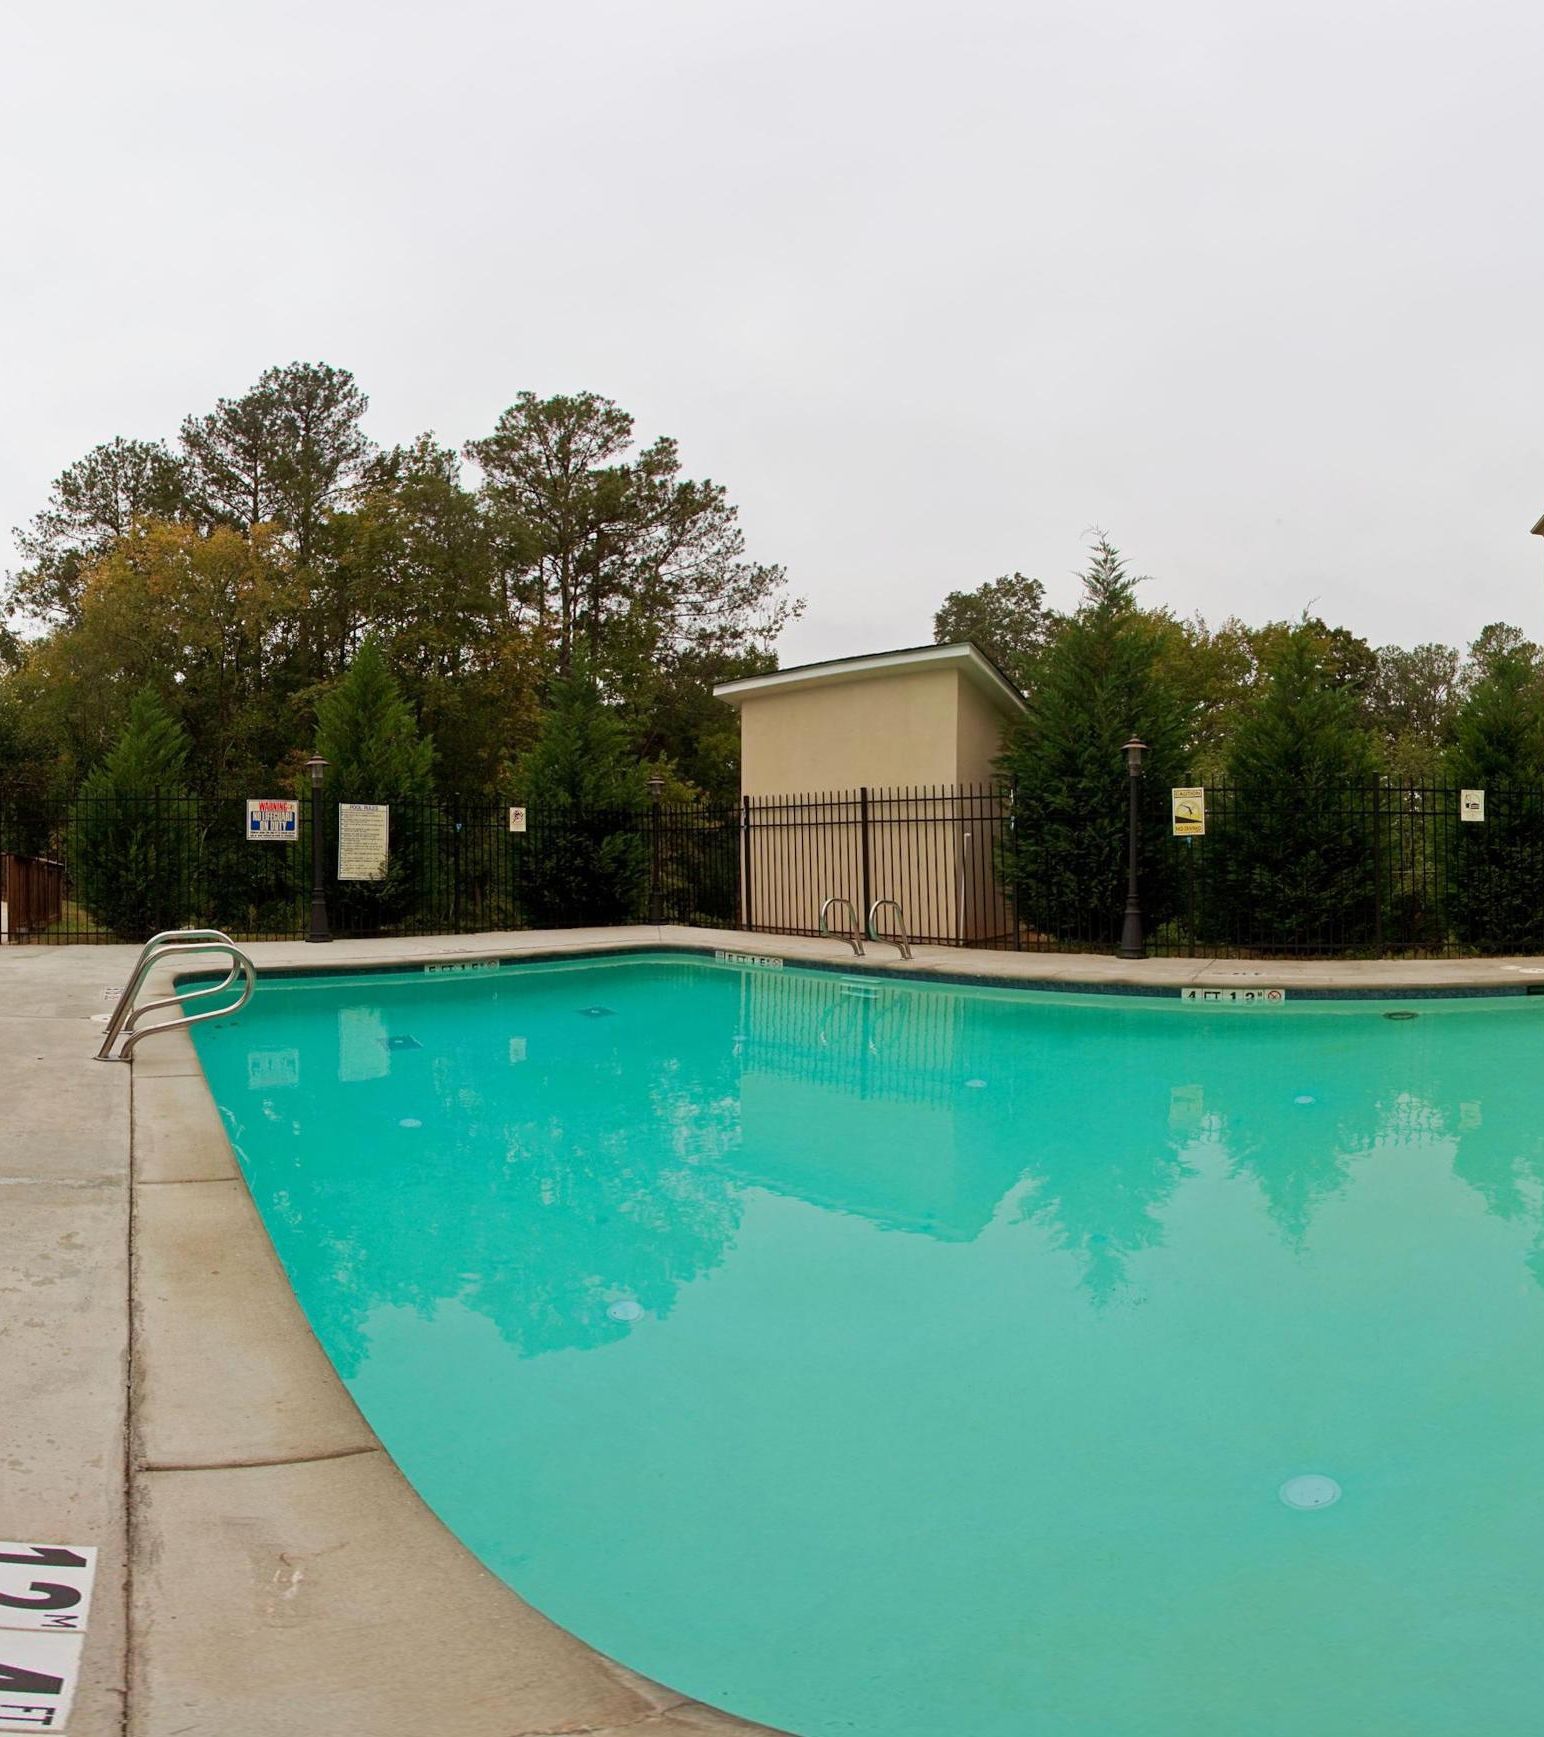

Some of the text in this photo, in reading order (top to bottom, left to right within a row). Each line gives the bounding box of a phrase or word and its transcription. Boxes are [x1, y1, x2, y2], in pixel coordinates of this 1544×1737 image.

[259, 801, 288, 811] WARNING
[253, 811, 262, 821] NO
[260, 821, 287, 831] ON DUTY
